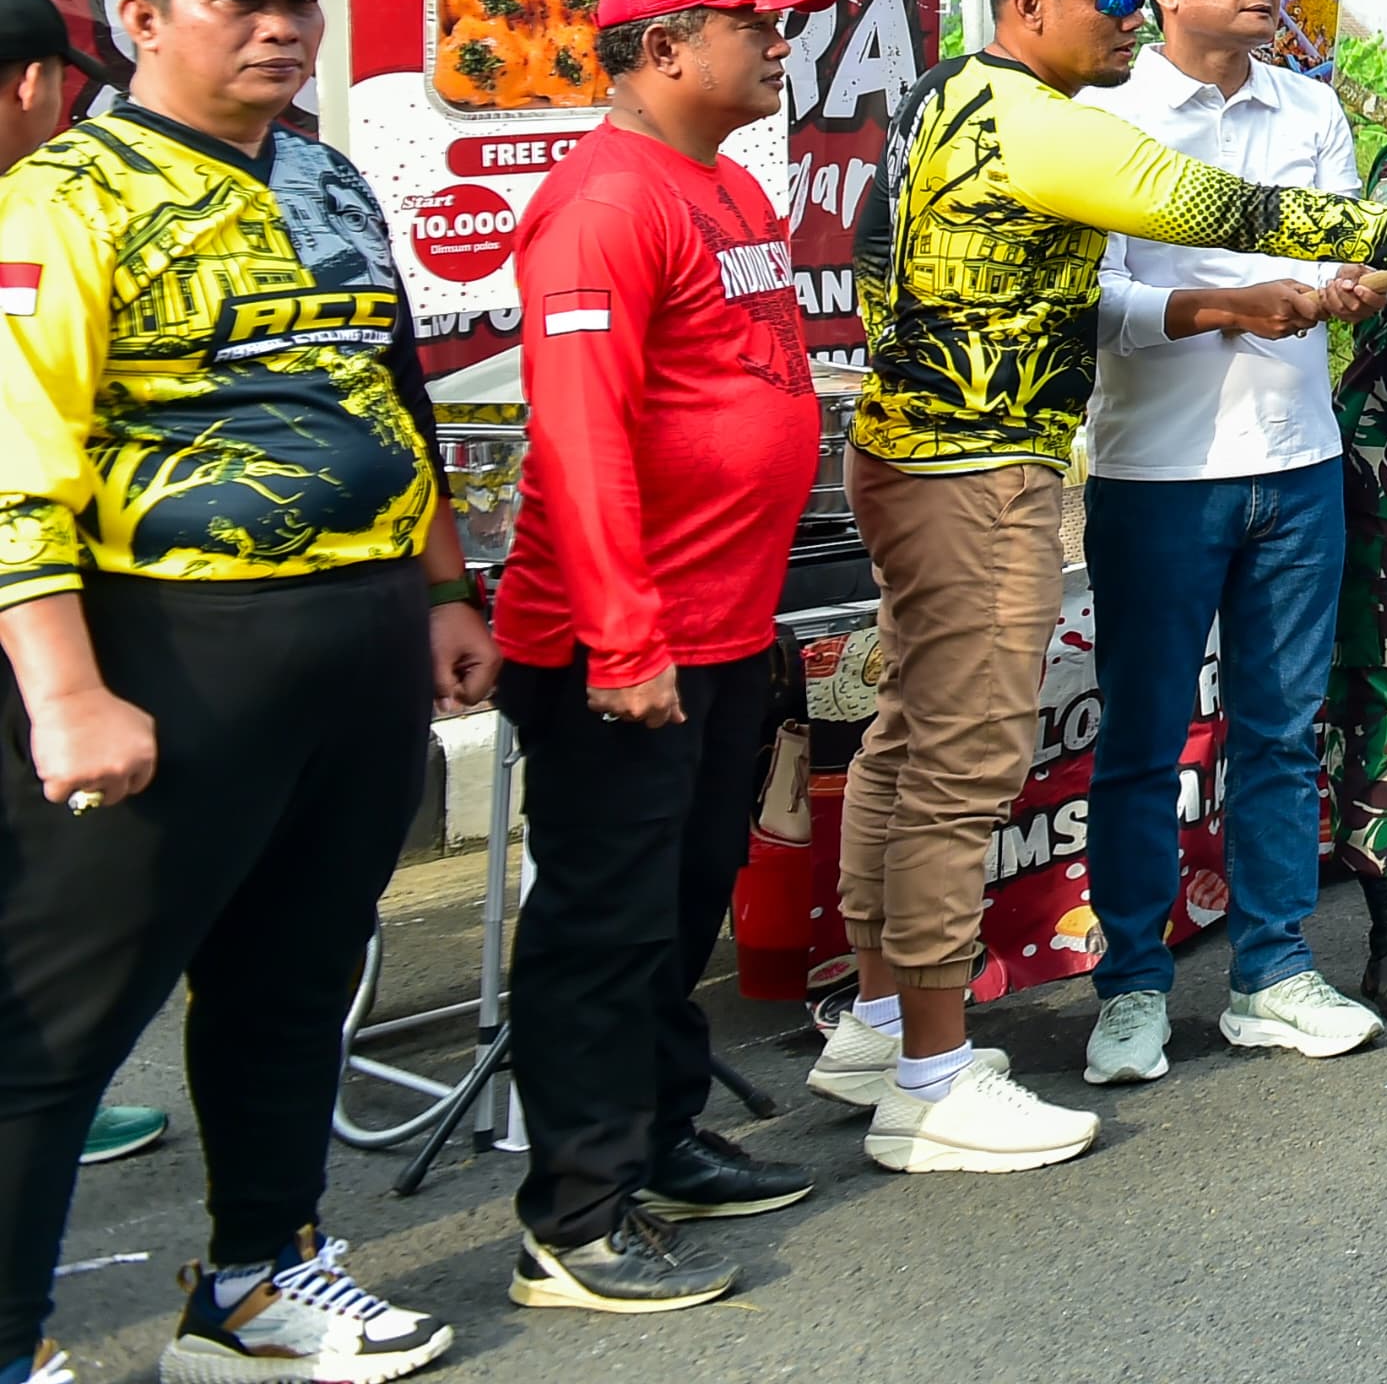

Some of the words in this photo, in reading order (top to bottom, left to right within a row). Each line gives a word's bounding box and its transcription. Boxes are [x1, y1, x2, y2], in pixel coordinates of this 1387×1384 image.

[481, 141, 547, 167] FREE
[401, 194, 456, 210] Start
[412, 210, 516, 240] 10.000
[228, 292, 398, 342] ACC
